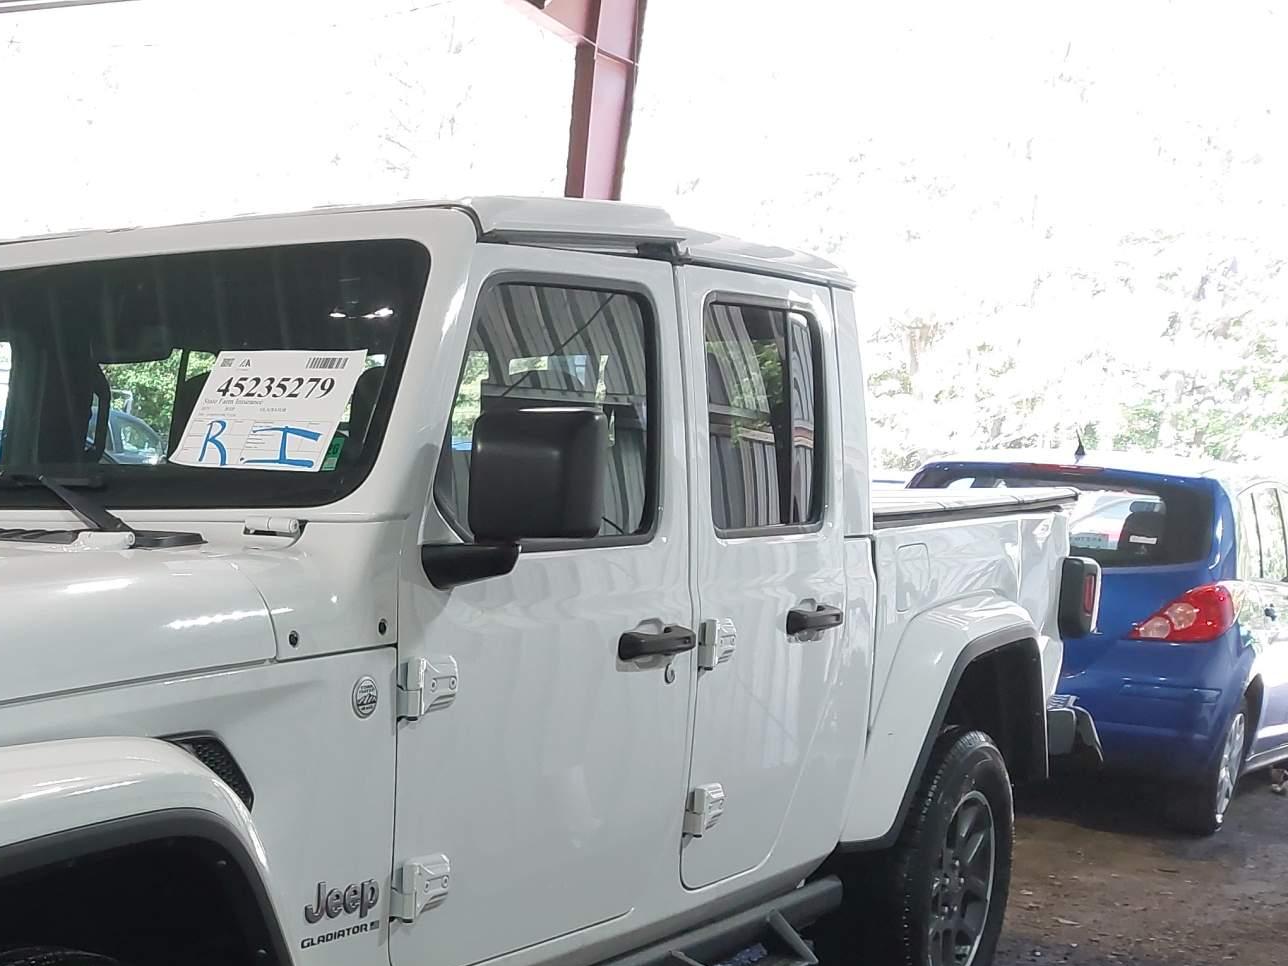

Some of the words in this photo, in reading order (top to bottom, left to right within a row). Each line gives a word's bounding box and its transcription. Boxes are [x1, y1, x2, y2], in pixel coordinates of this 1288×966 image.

[216, 376, 336, 399] 45235279
[198, 420, 227, 467] R
[304, 879, 380, 924] Jeep
[300, 923, 369, 949] GLADIATOR
